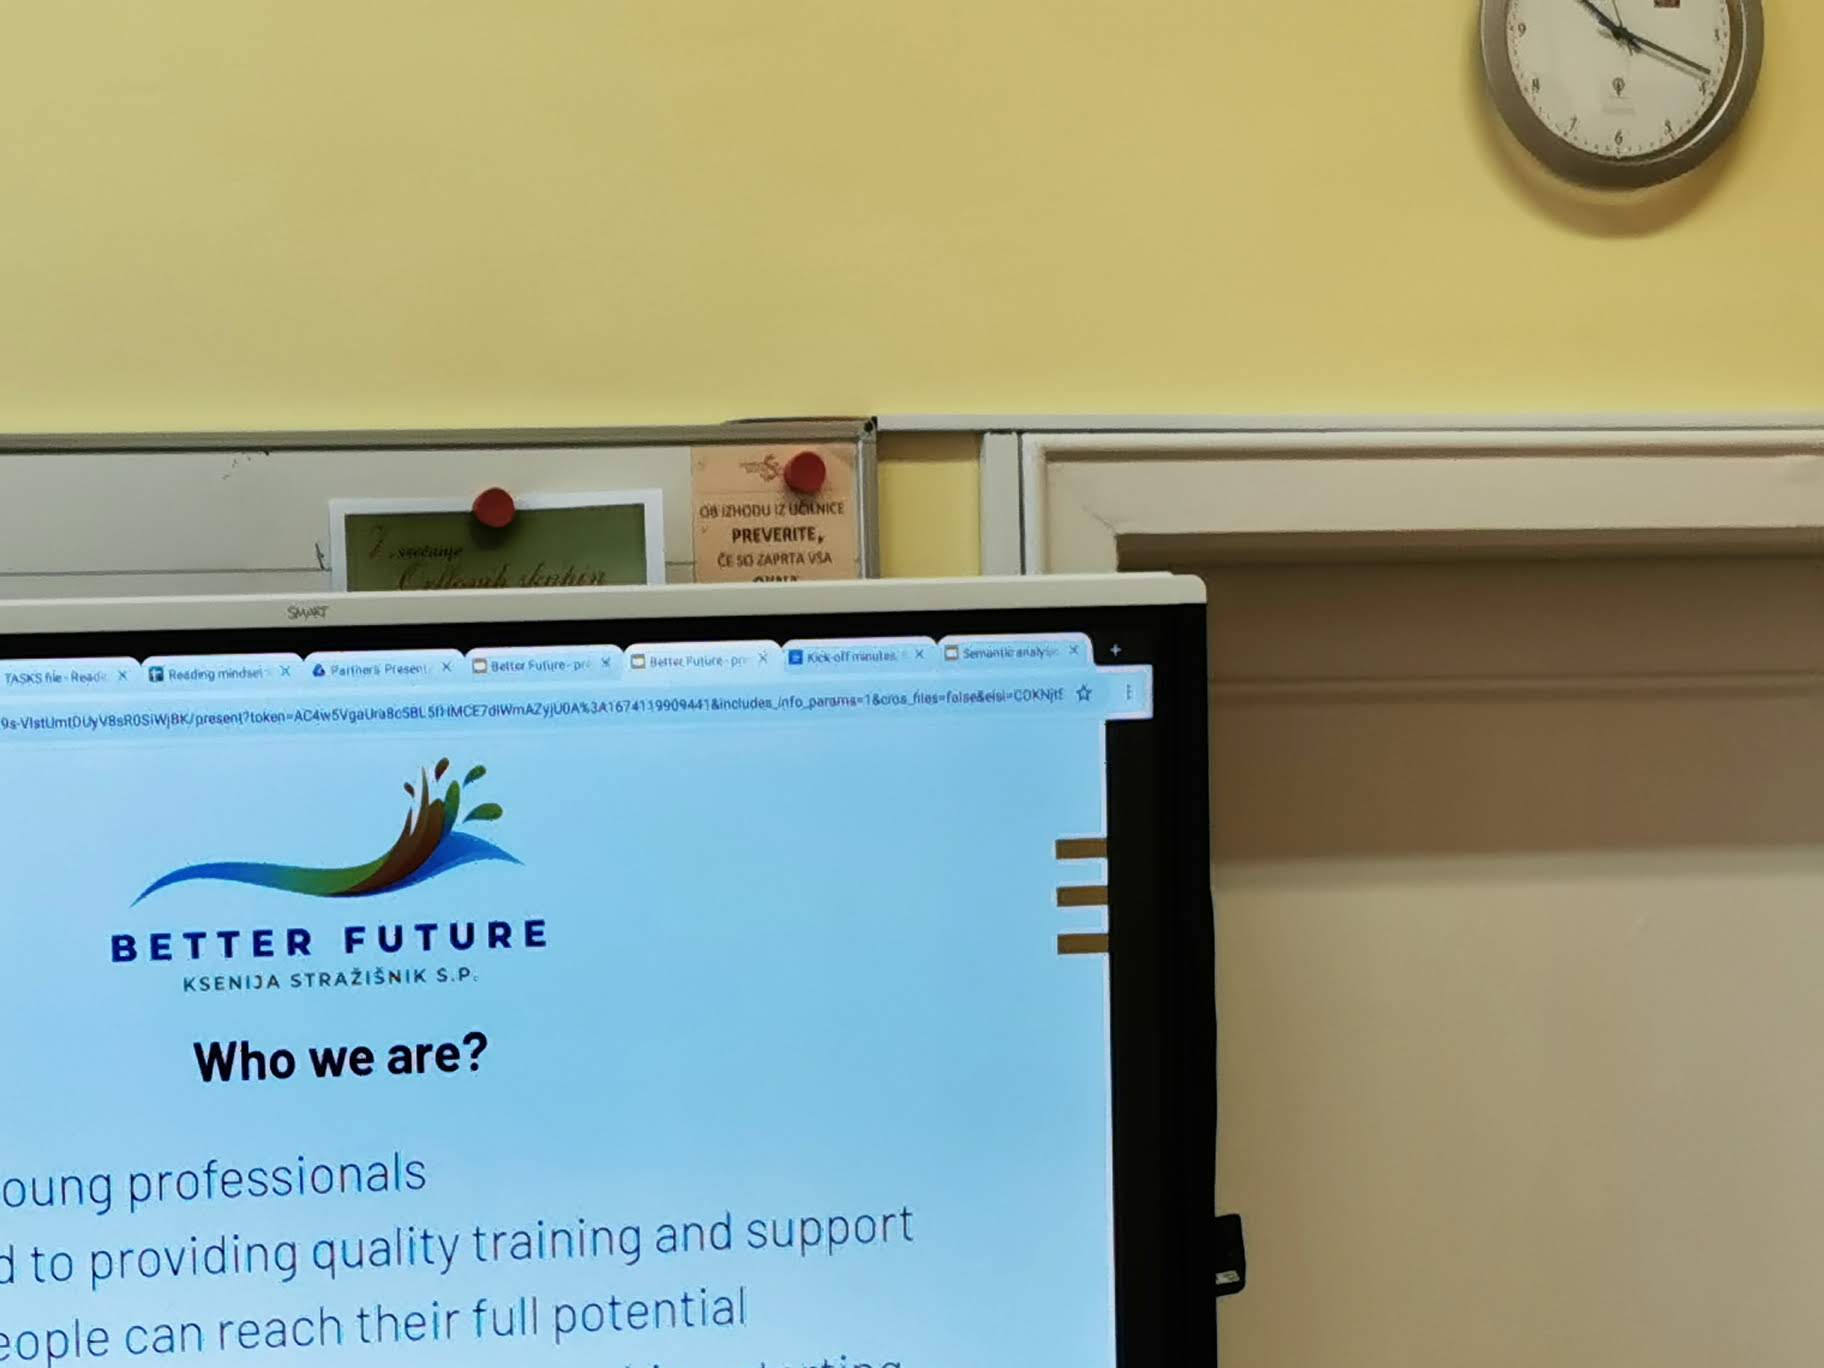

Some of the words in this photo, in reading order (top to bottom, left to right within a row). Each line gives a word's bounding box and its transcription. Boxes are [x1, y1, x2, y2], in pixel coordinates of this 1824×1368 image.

[1518, 23, 1526, 37] 9
[1615, 131, 1623, 146] 6
[722, 504, 770, 518] IZHODU
[774, 504, 785, 516] IZ
[789, 501, 844, 515] UČILNICE
[732, 526, 824, 544] PREVERITE,
[717, 551, 734, 567] ČE
[737, 555, 753, 566] SO
[757, 553, 804, 565] ZAPRTA
[808, 650, 849, 663] Kick-off
[852, 652, 897, 662] minutes
[962, 646, 1014, 659] Semantic
[491, 659, 525, 672] Better
[528, 658, 566, 673] Future
[650, 656, 683, 668] Better
[686, 656, 723, 668] Future
[5, 672, 42, 684] TASKS
[45, 670, 62, 682] file
[169, 669, 215, 681] Reading
[110, 927, 313, 962] BETTER
[343, 919, 547, 954] FUTURE
[183, 973, 281, 993] KSENIJA
[290, 966, 427, 988] STRAŽIŠNIK
[436, 967, 478, 983] S.P.
[193, 1040, 296, 1083] Who
[310, 1045, 374, 1078] we
[387, 1031, 488, 1075] are?
[129, 1152, 426, 1214] professionals
[31, 1246, 74, 1284] to
[91, 1234, 298, 1290] providing
[312, 1224, 457, 1279] quality
[472, 1218, 642, 1265] training
[655, 1211, 733, 1253] and
[746, 1205, 914, 1256] support
[124, 1320, 204, 1355] can
[219, 1306, 342, 1350] reach
[357, 1301, 460, 1345] their
[472, 1295, 538, 1339] full
[553, 1286, 747, 1345] potential
